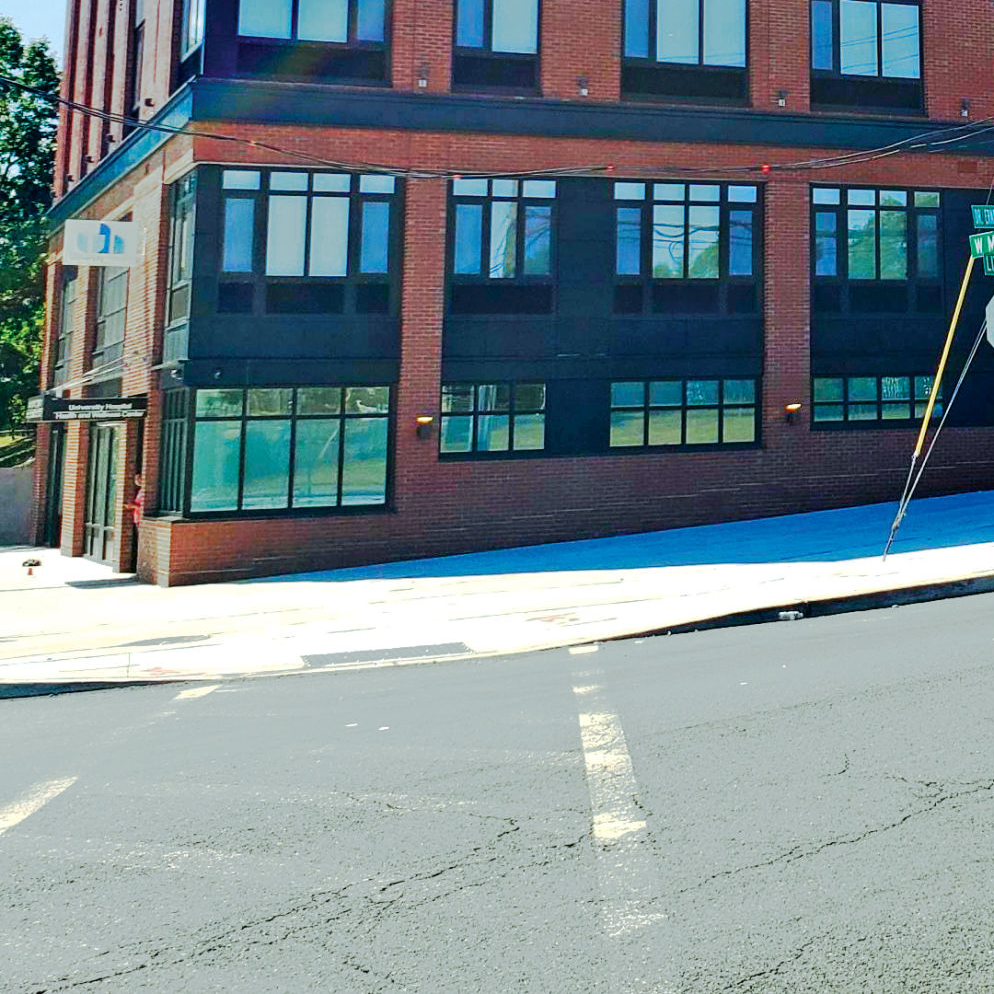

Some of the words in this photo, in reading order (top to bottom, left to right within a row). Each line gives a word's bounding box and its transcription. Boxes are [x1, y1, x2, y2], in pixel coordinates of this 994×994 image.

[974, 238, 983, 254] W
[68, 404, 105, 412] University
[105, 403, 133, 411] Hospital
[55, 412, 77, 420] Health
[91, 411, 121, 419] Wellness
[121, 410, 145, 418] Center
